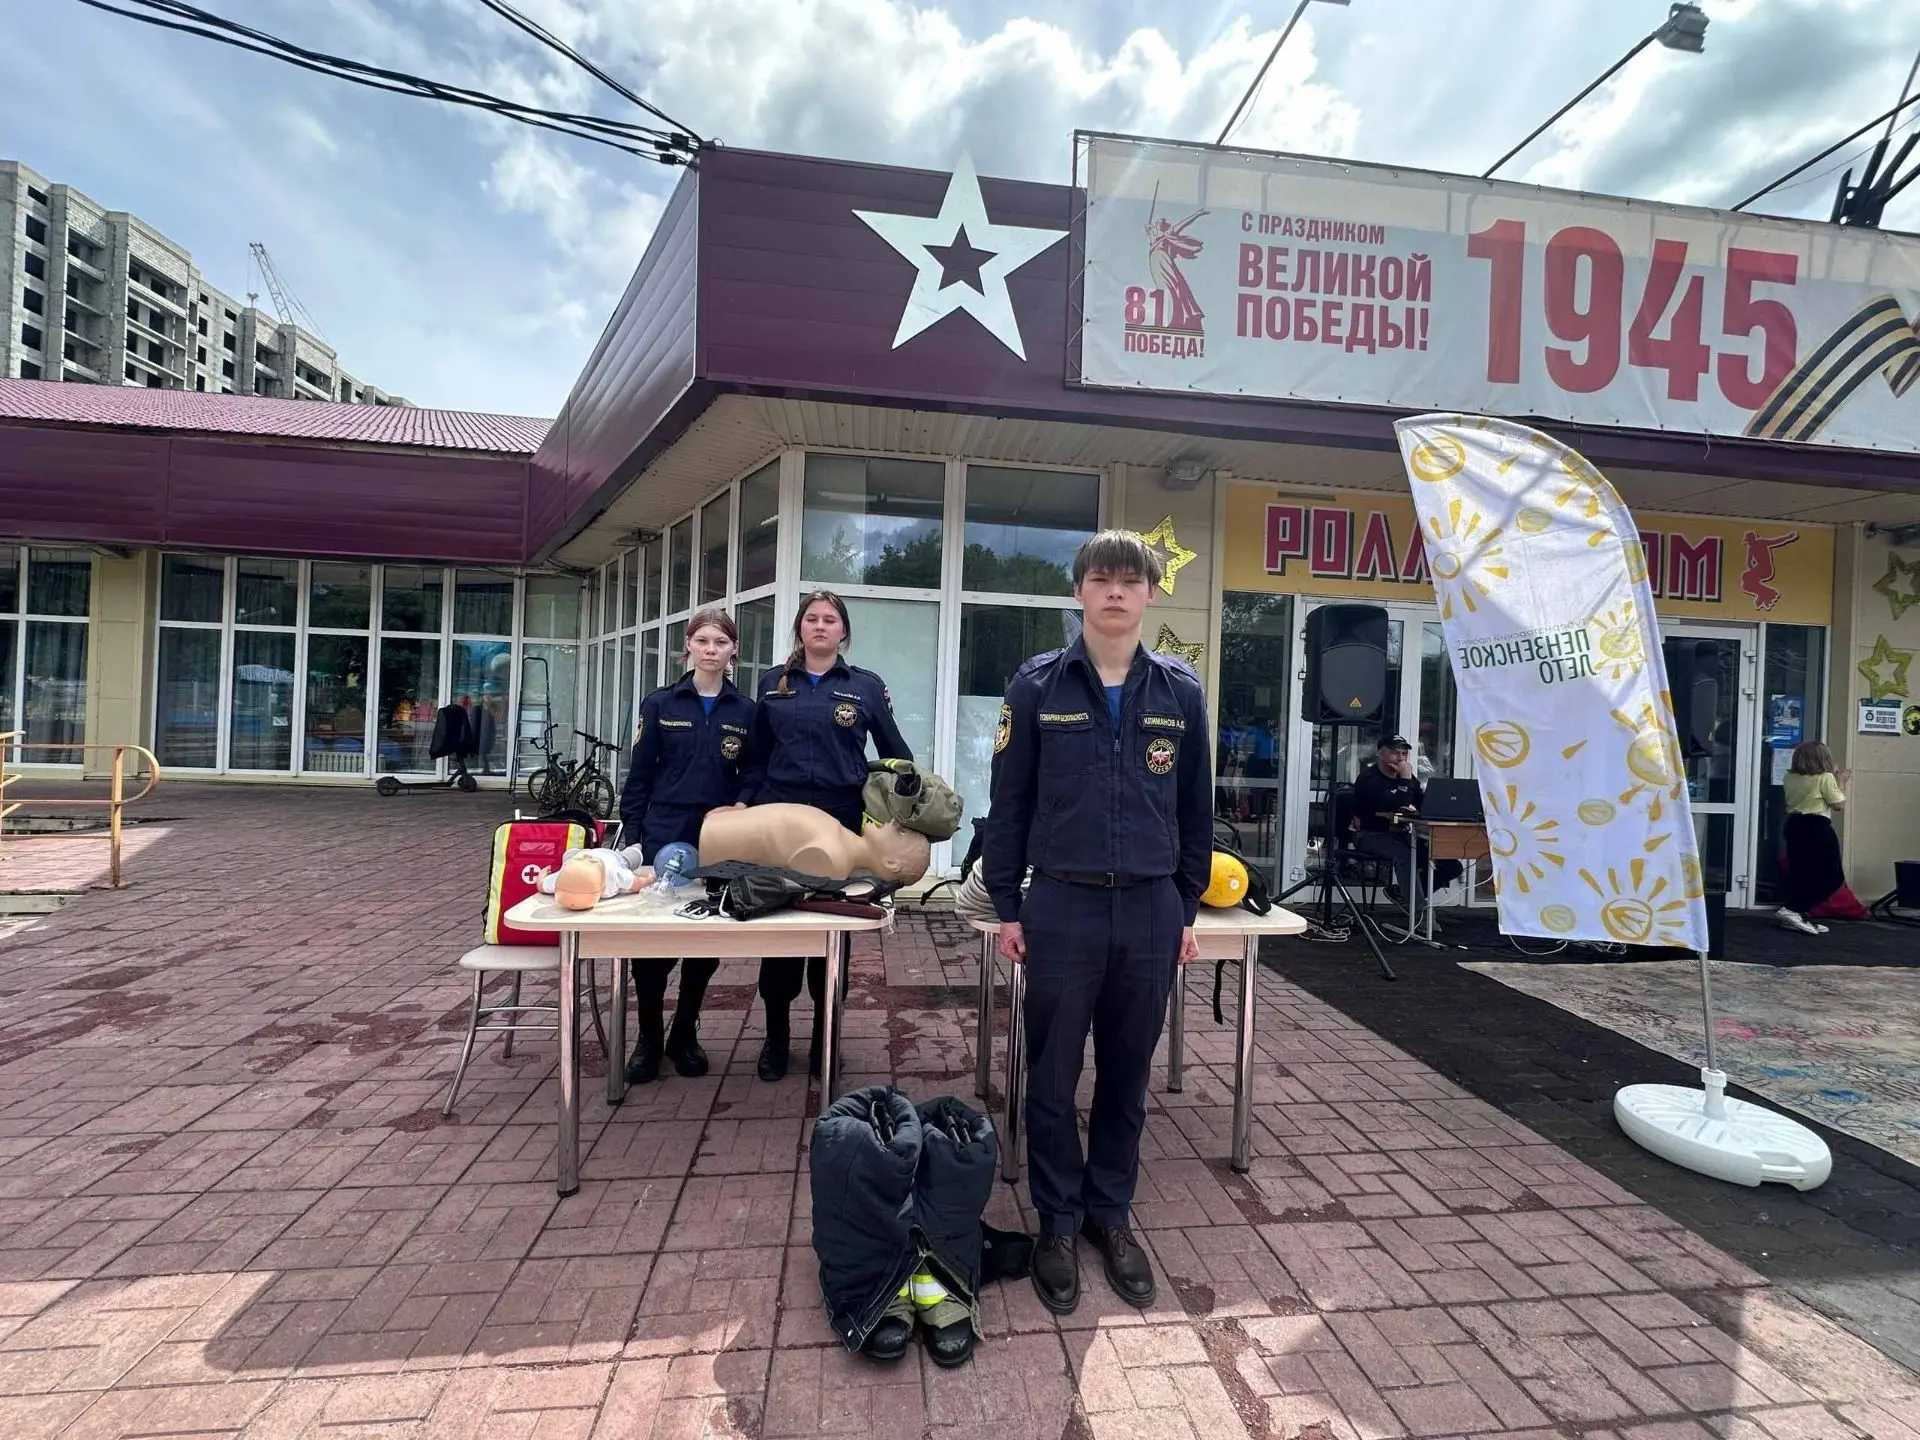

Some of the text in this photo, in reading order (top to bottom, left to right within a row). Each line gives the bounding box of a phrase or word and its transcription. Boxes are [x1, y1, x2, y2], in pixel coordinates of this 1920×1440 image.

[1242, 212, 1385, 245] С ПРАЗДНИКОМ
[1238, 243, 1432, 302] ВЕЛИКОЙ
[1124, 286, 1165, 327] 81
[1237, 293, 1429, 354] ПОБЕДЫ!
[1467, 219, 1799, 411] 1945
[1124, 332, 1205, 359] ПОБЕДА!
